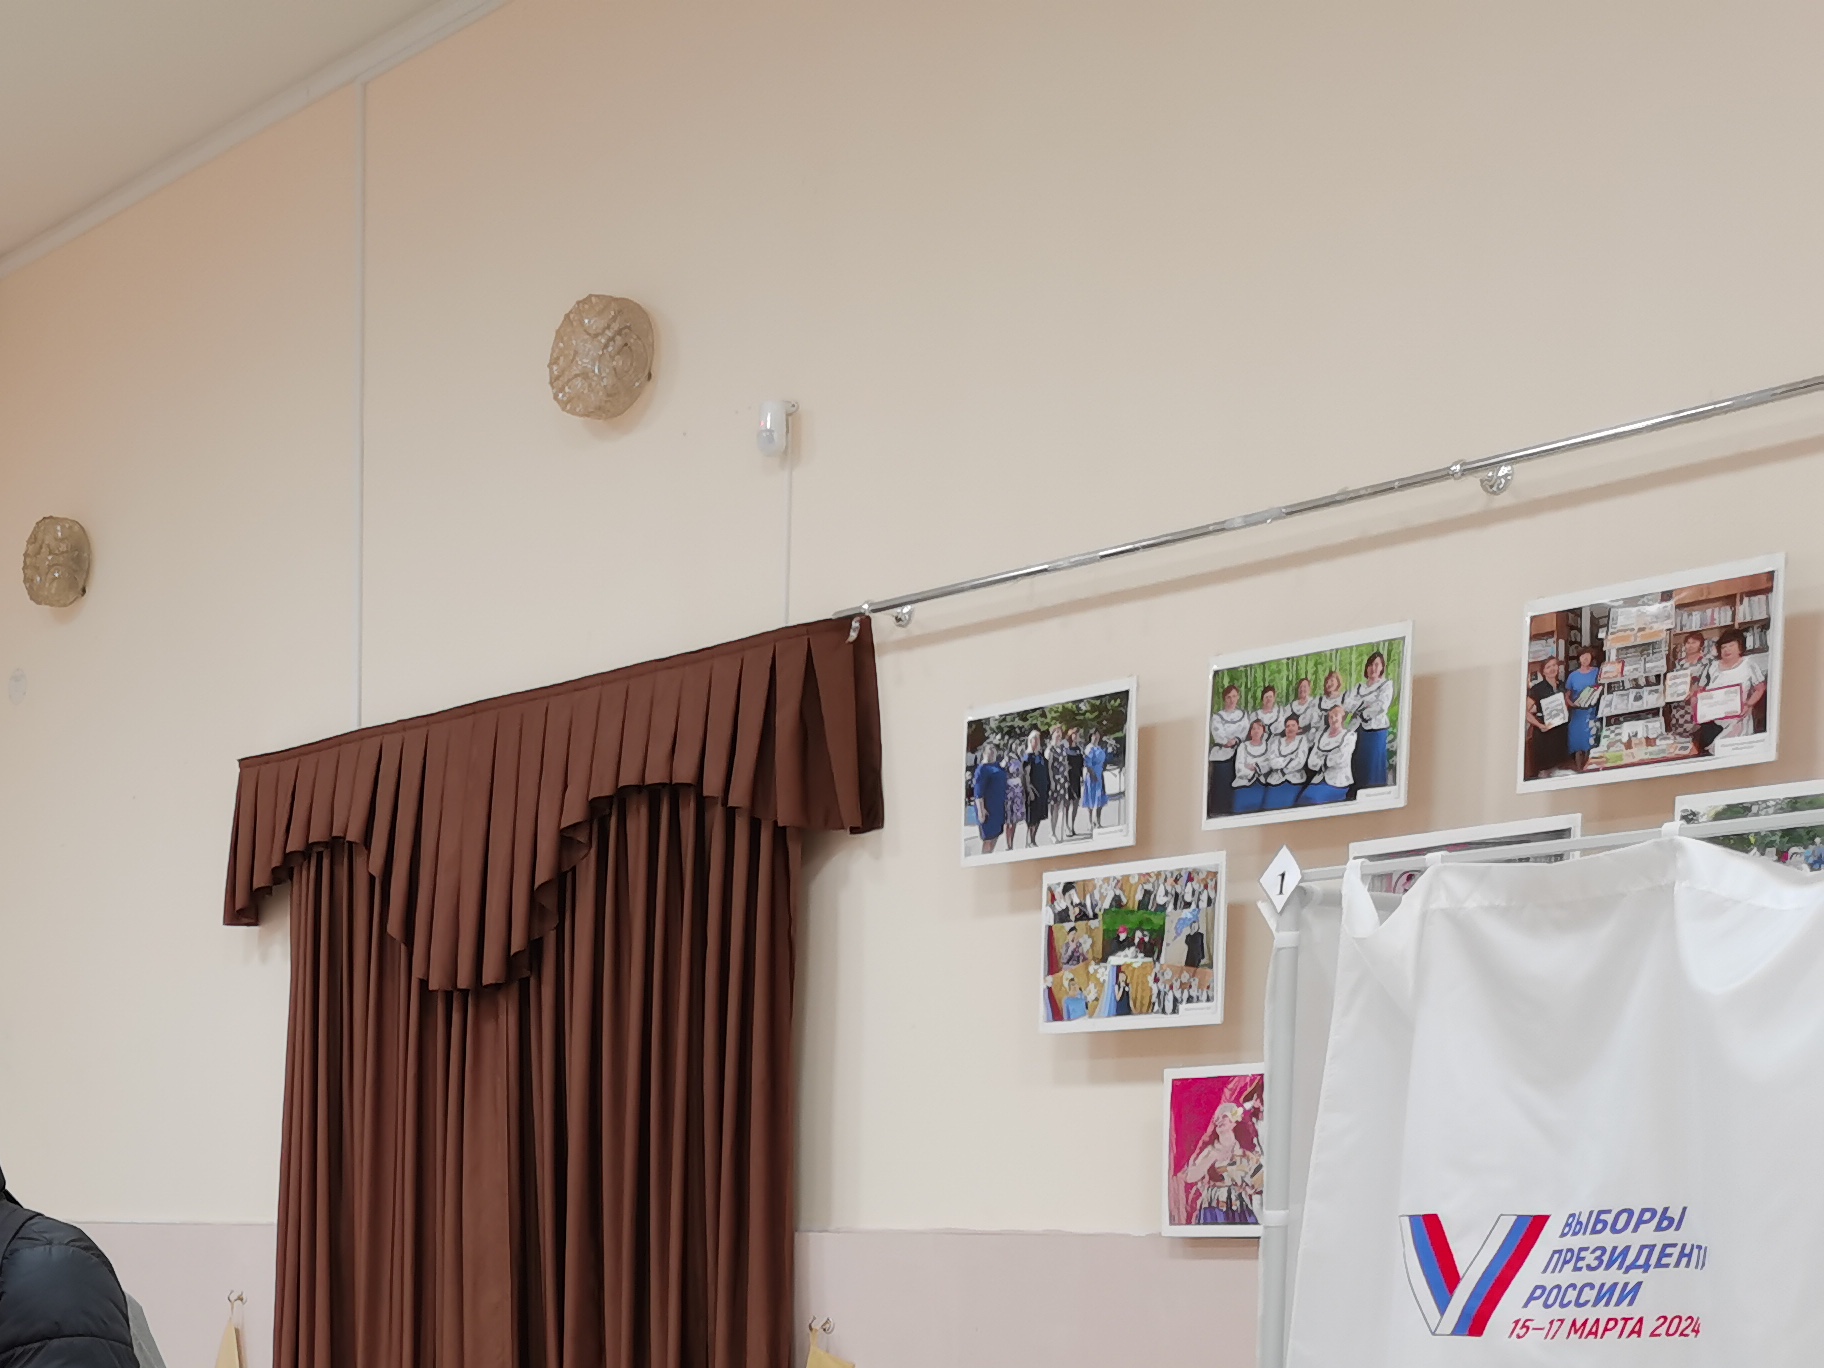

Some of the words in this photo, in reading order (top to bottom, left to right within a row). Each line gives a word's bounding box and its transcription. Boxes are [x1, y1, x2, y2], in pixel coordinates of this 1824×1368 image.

[1275, 870, 1286, 896] 1
[1558, 1205, 1688, 1239] ВЫБОРЫ
[1521, 1280, 1644, 1310] РОССИИ
[1565, 1315, 1644, 1341] МАРТА
[1648, 1314, 1701, 1339] 2024
